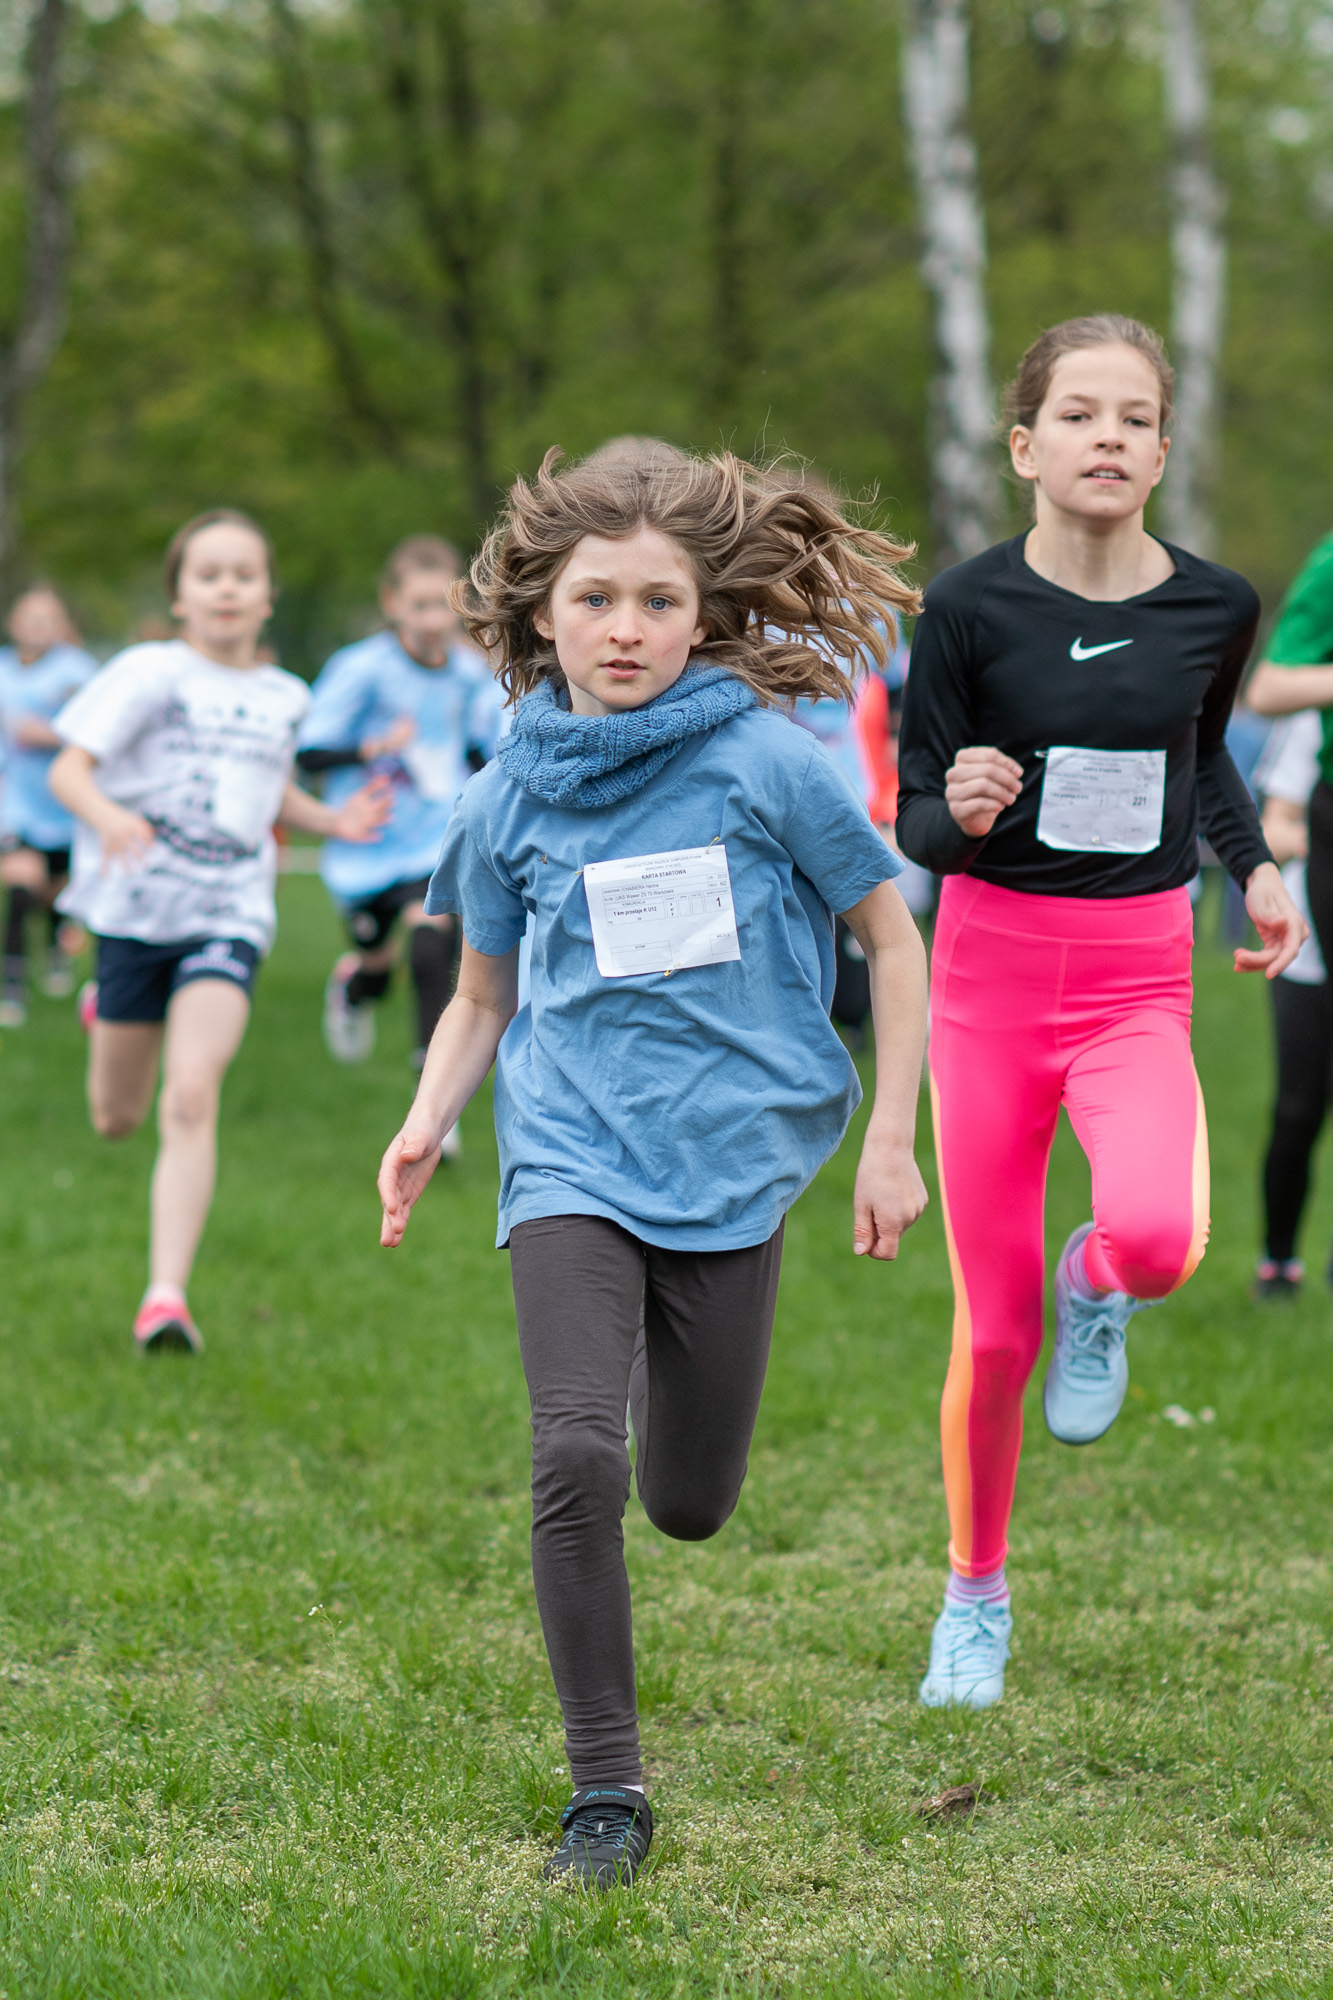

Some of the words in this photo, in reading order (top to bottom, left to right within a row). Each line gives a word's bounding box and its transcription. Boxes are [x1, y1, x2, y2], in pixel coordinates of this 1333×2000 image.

[1132, 796, 1147, 807] 221
[659, 869, 687, 879] STARTOWA
[715, 896, 722, 908] 1
[647, 906, 658, 914] U12
[600, 1790, 626, 1798] martes
